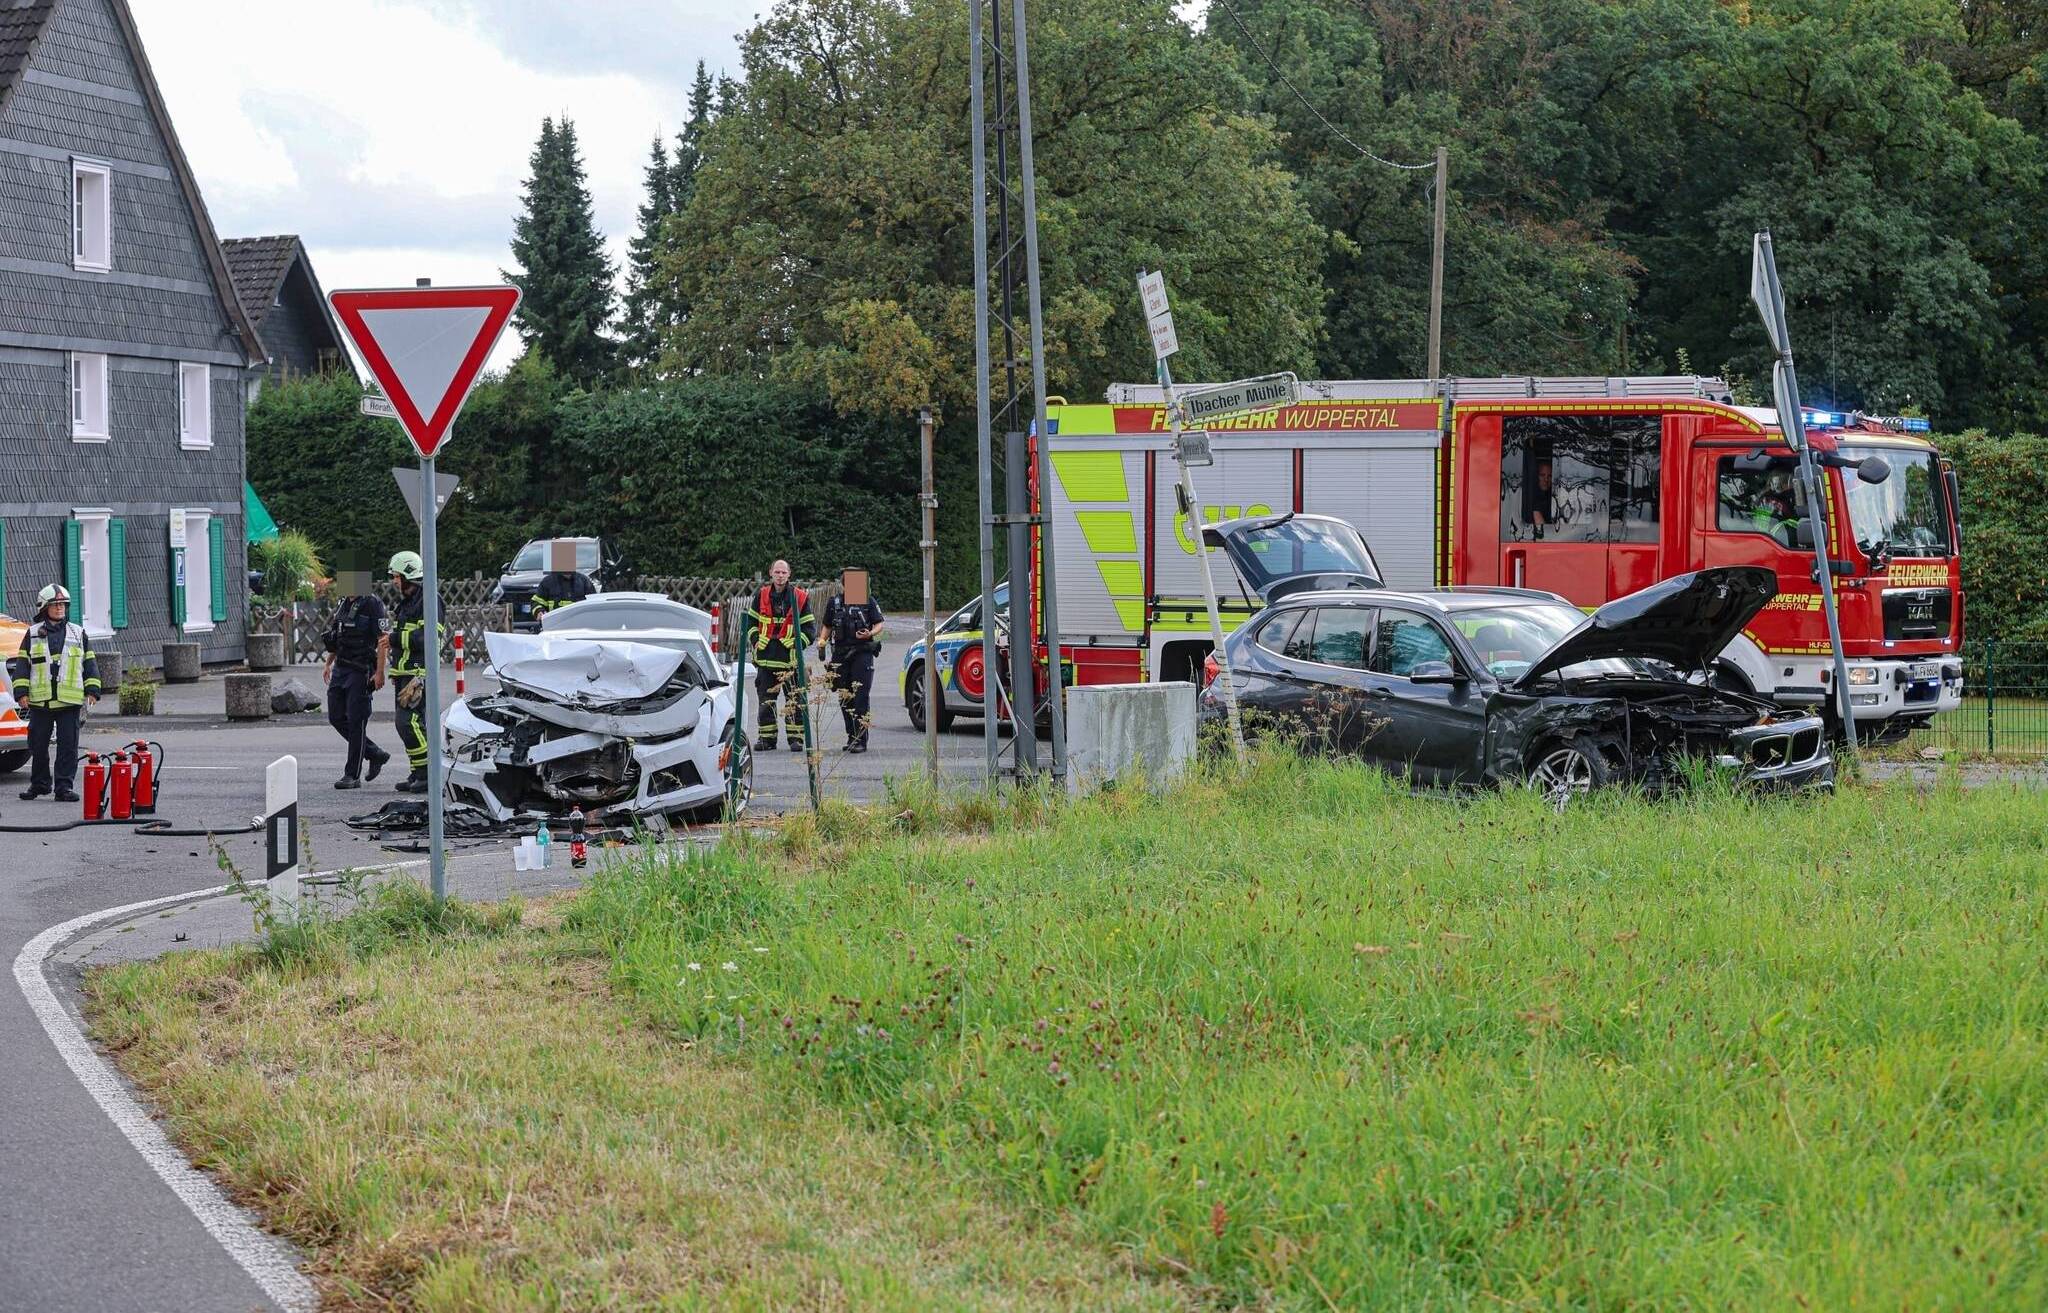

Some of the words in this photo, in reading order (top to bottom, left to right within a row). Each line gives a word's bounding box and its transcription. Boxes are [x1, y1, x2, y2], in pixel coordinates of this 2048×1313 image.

[1190, 395, 1240, 414] Ibacher
[1246, 384, 1286, 403] Mühle
[1286, 409, 1400, 429] WUPPERTAL
[1888, 565, 1949, 586] FEUERWEHR
[1762, 602, 1807, 611] UPPERTAL
[1908, 606, 1933, 620] MAN
